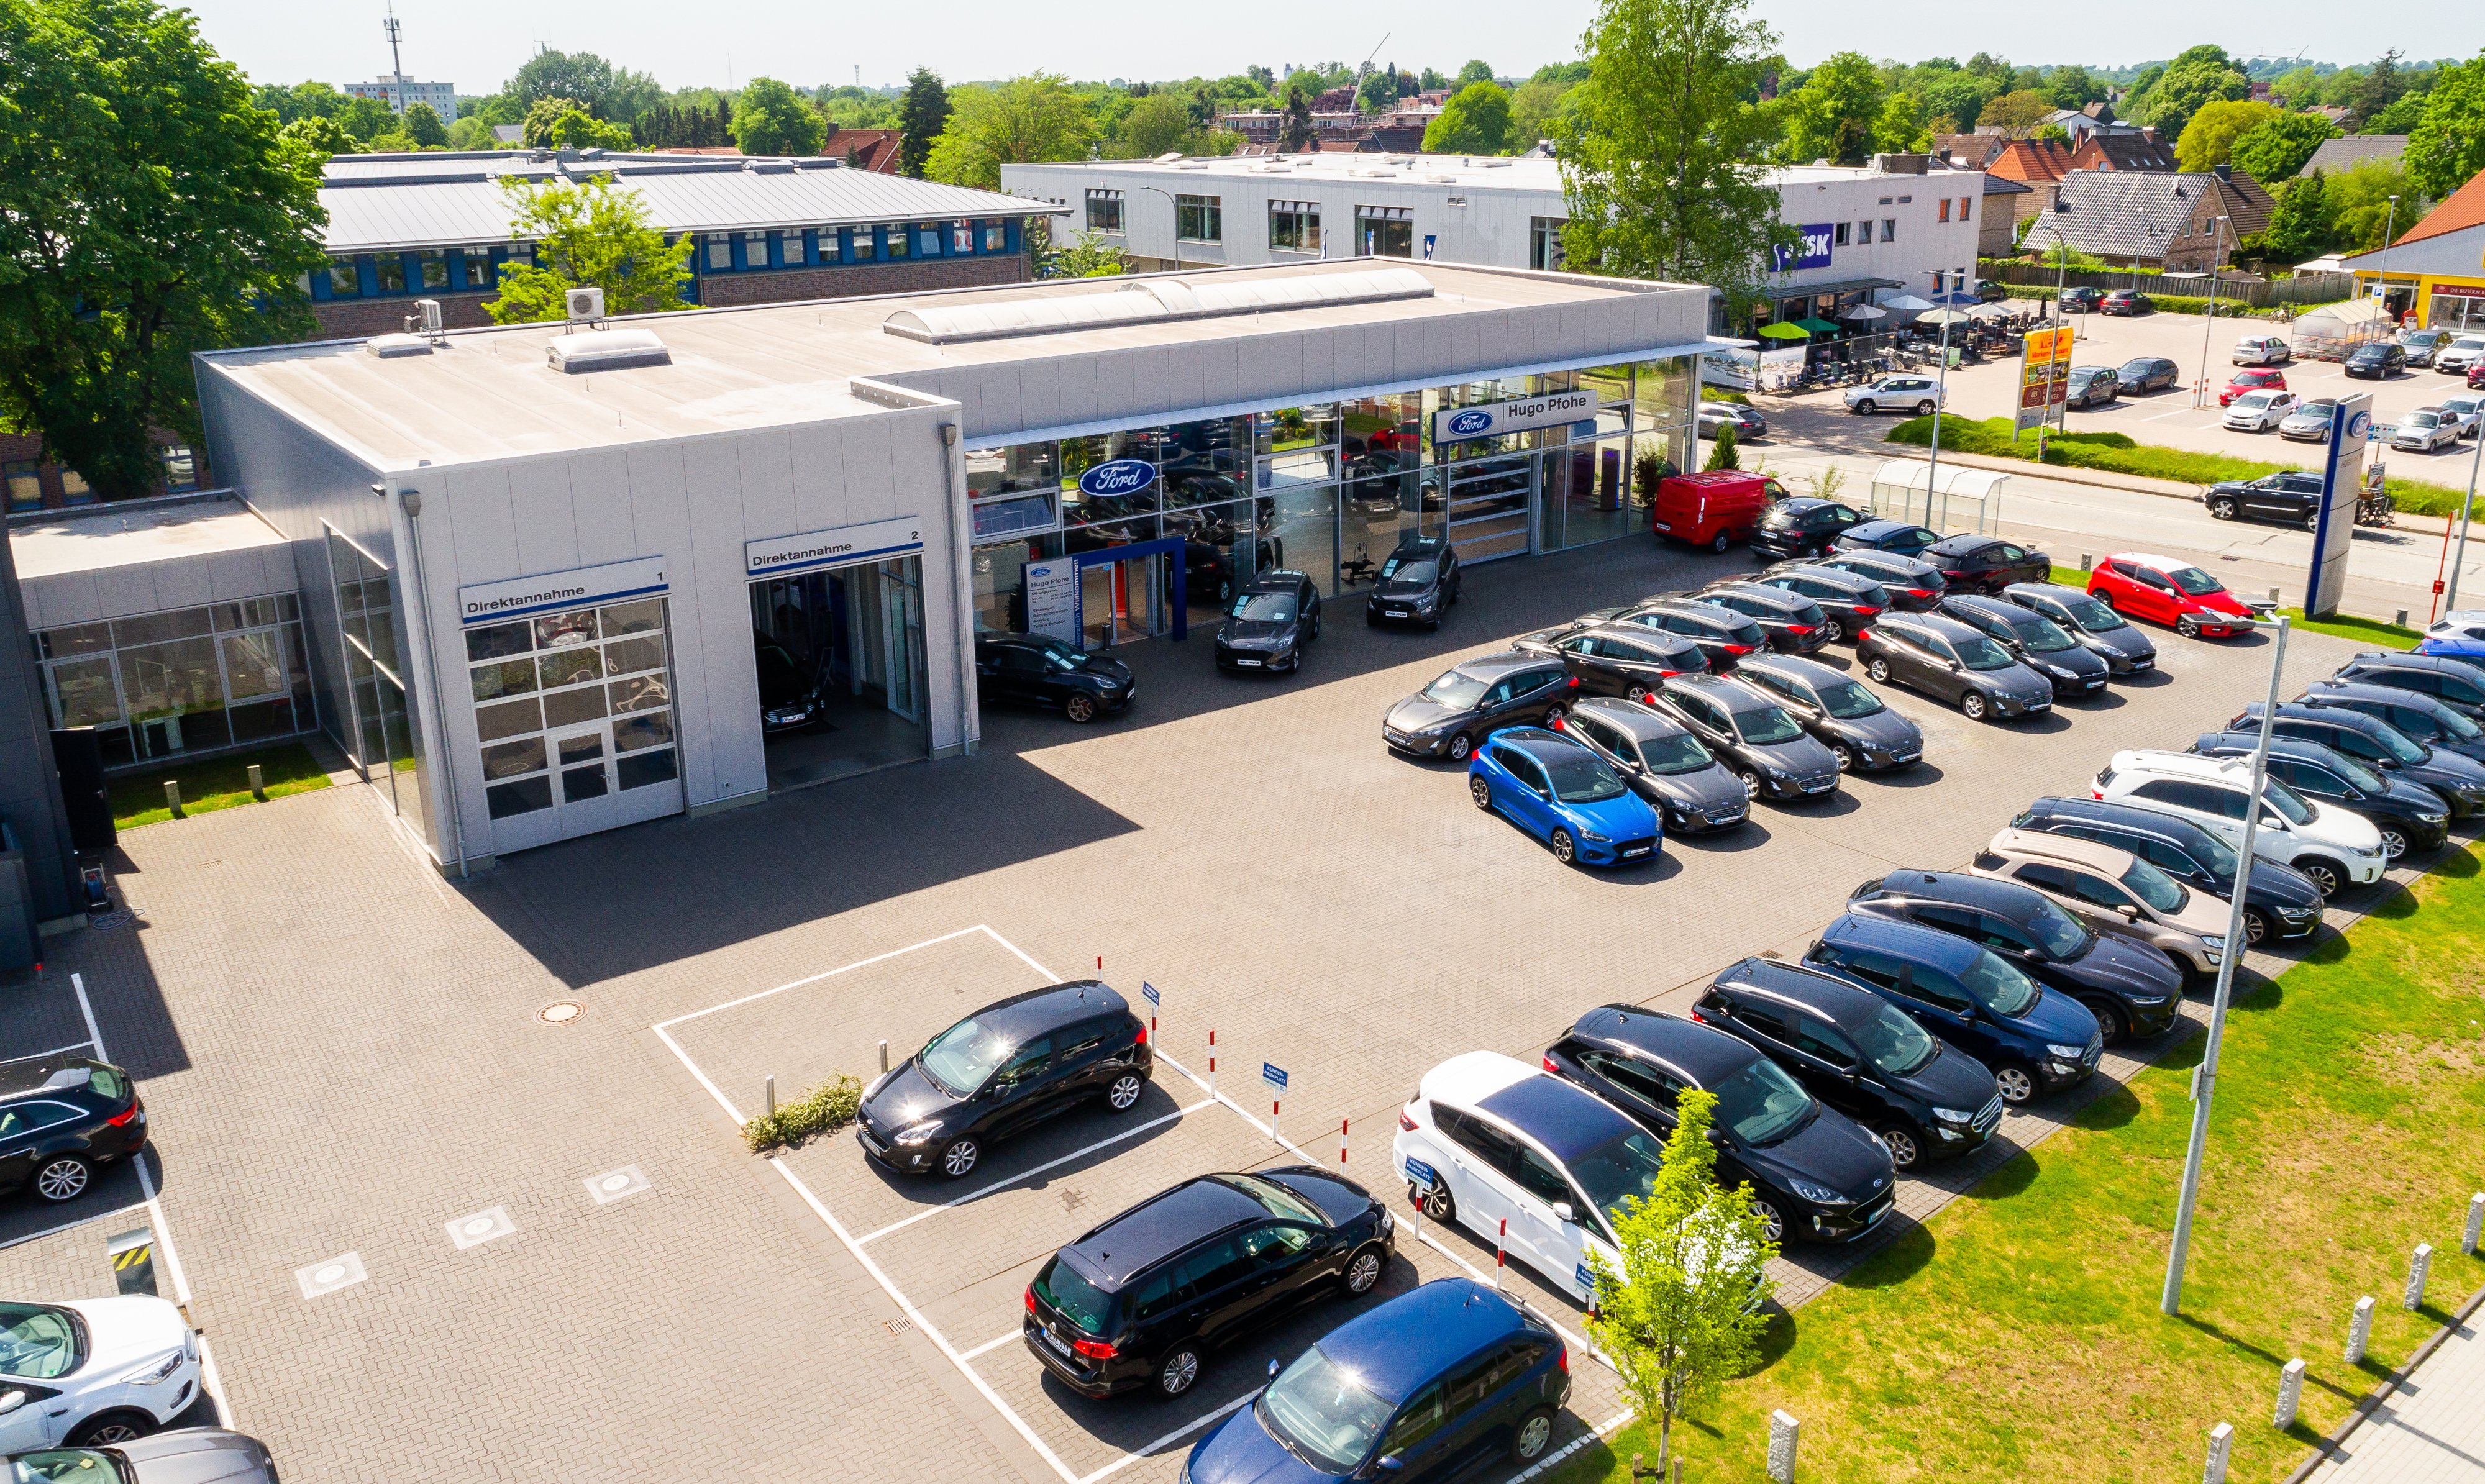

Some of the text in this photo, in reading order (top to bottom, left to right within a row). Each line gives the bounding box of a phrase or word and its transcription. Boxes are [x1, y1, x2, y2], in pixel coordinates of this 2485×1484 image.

[2038, 332, 2064, 349] Neo
[1508, 396, 1587, 418] Hugo Pfohe
[1459, 414, 1485, 432] Ford
[1095, 465, 1141, 490] Ford
[752, 530, 919, 567] Direktannahme 2
[1051, 576, 1070, 585] Pfohe
[467, 571, 663, 614] Direktannahme 1
[1264, 1070, 1286, 1085] PARKPLATZ
[1267, 1066, 1284, 1077] KUNDEN-
[1407, 1162, 1431, 1181] PARKPLATZ
[1410, 1159, 1428, 1173] KUNDEN-
